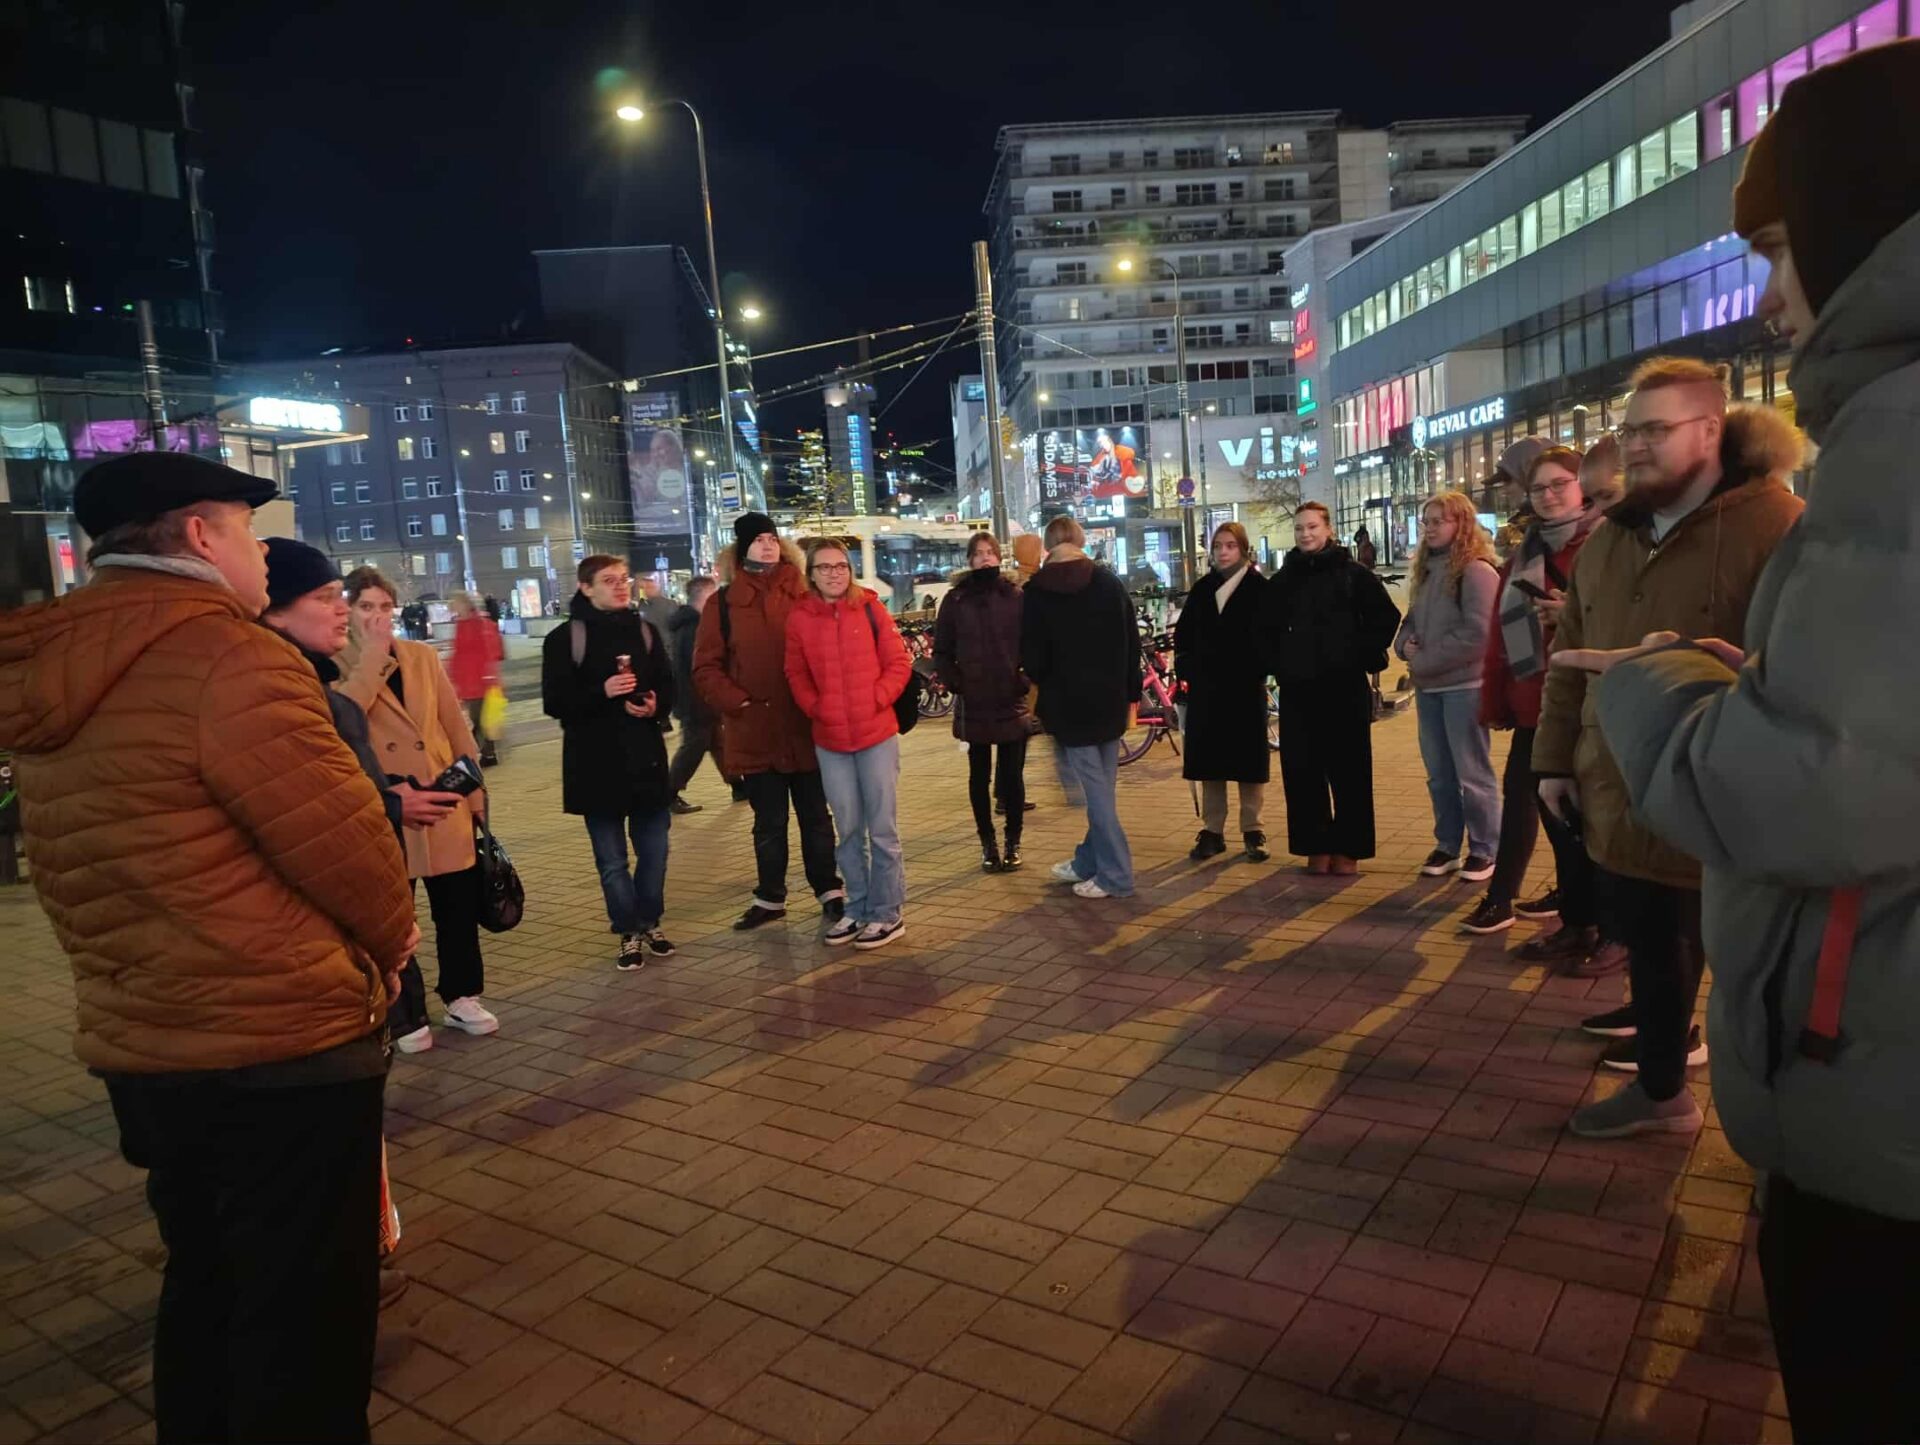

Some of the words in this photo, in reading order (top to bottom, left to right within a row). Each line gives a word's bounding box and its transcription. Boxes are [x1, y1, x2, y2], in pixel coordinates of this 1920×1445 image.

[1429, 411, 1468, 439] REVAL
[1470, 397, 1504, 426] CAFÉ
[1044, 435, 1058, 497] SÜDAMES
[1218, 427, 1299, 466] vir
